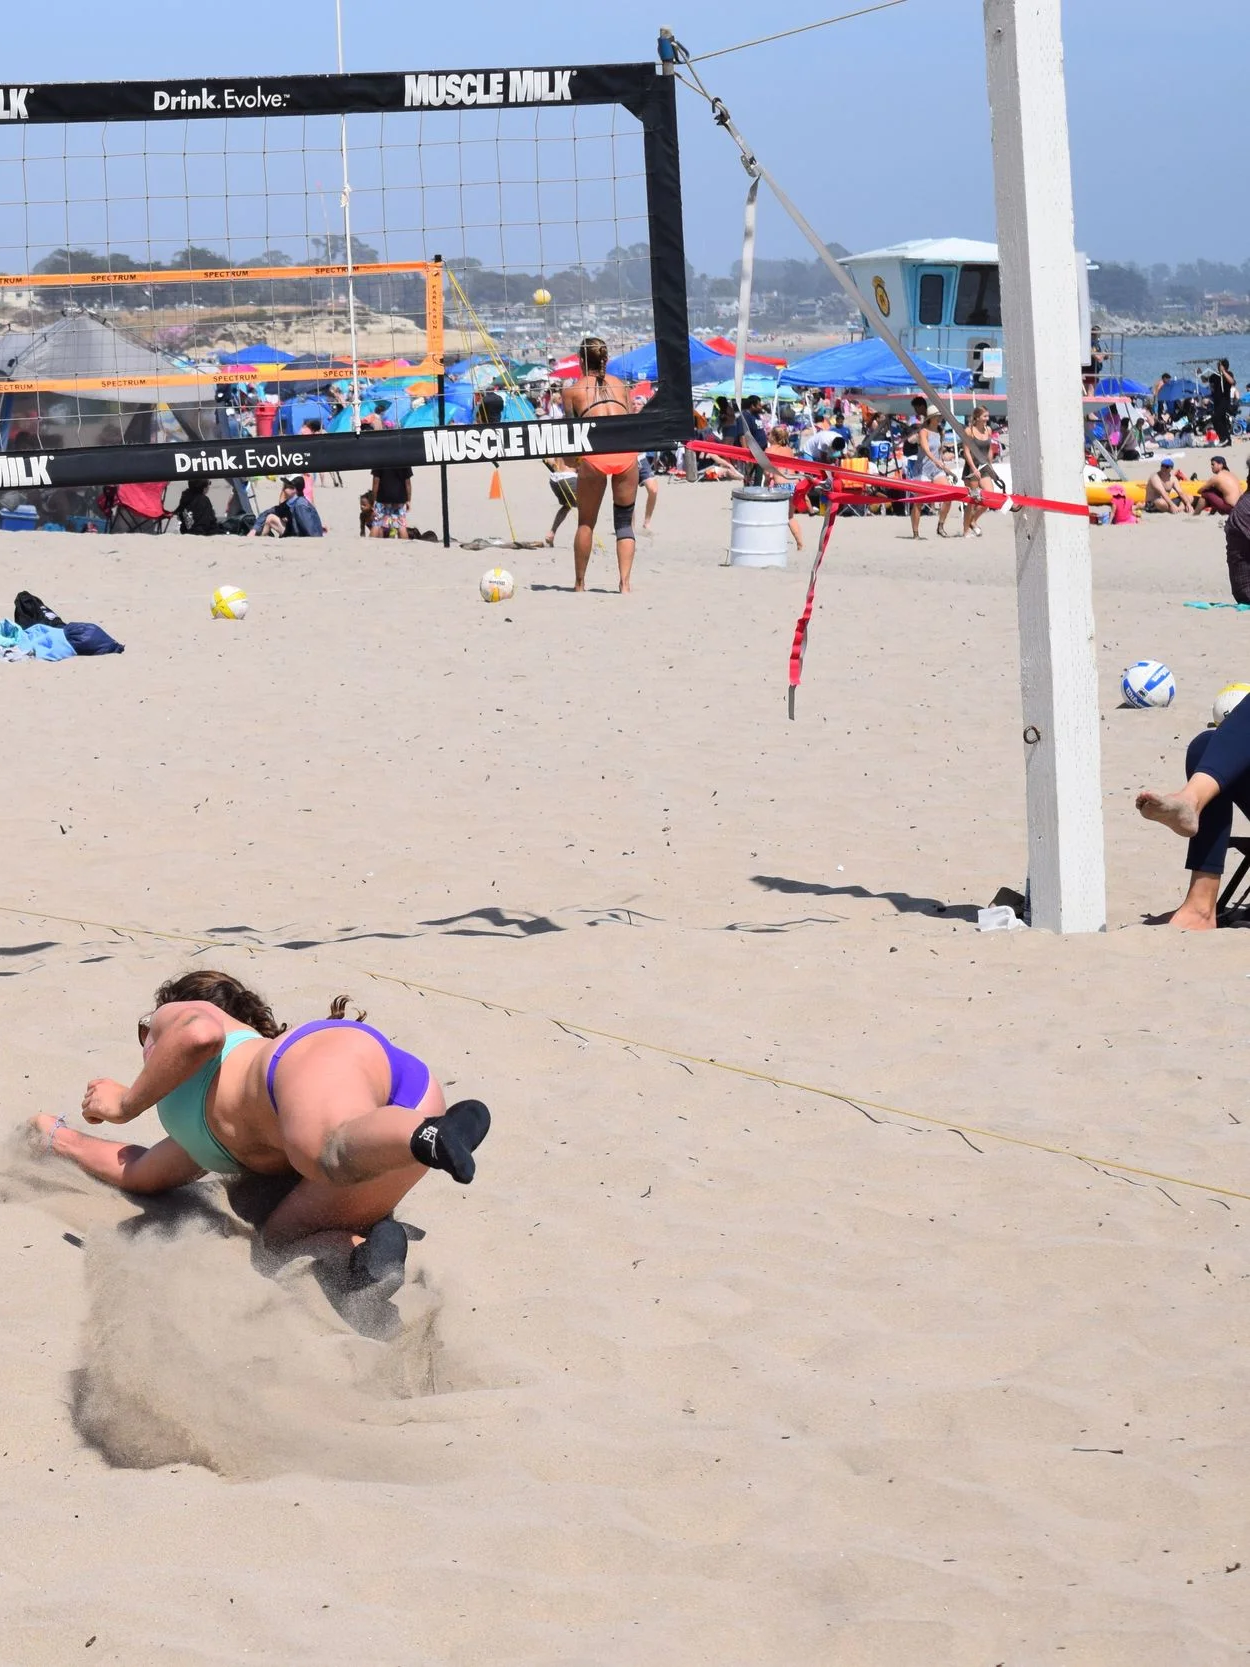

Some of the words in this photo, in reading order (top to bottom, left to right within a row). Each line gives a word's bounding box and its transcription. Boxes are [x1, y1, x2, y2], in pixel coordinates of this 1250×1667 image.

[405, 73, 503, 106] MUSCLE
[509, 70, 572, 103] MILK
[154, 88, 221, 111] Drink.
[91, 274, 137, 282] SPECTRUM
[204, 270, 249, 278] SPECTRUM
[101, 379, 147, 387] SPECTRUM
[213, 374, 258, 382] SPECTRUM
[423, 427, 524, 462] MUSCLE
[528, 423, 593, 455] MILK
[175, 450, 243, 473] Drink.
